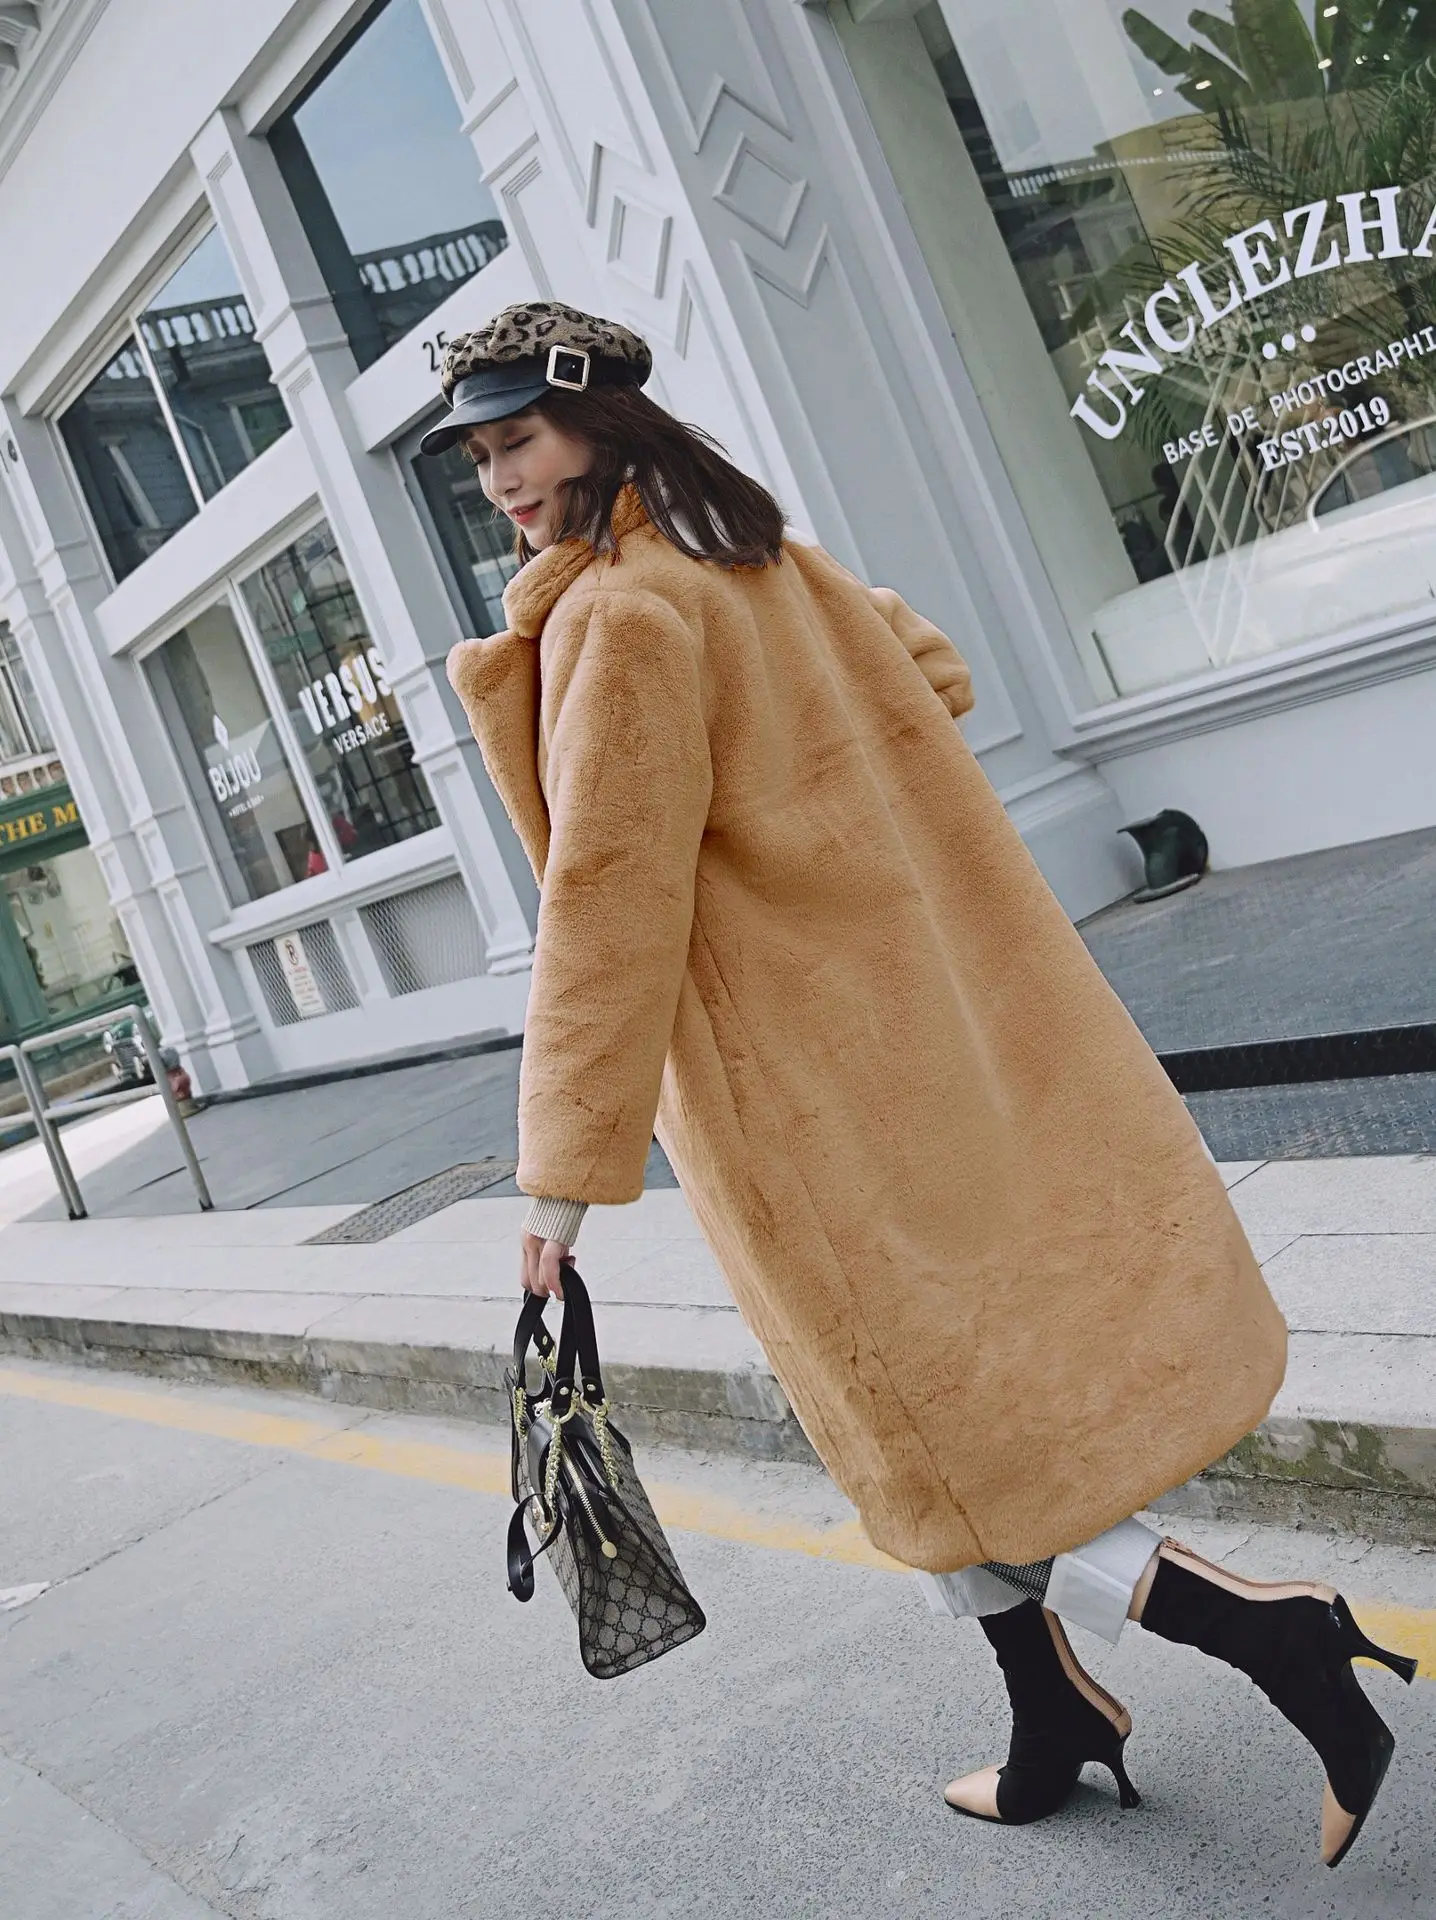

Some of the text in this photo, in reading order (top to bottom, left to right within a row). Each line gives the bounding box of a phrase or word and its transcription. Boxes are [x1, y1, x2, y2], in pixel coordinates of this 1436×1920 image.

[1162, 424, 1219, 464] BASE
[1226, 406, 1259, 437] DE
[1256, 396, 1391, 471] EST.2019
[298, 647, 392, 735] VERSUS
[332, 712, 391, 755] VERSACE
[208, 747, 261, 802] BIJOU
